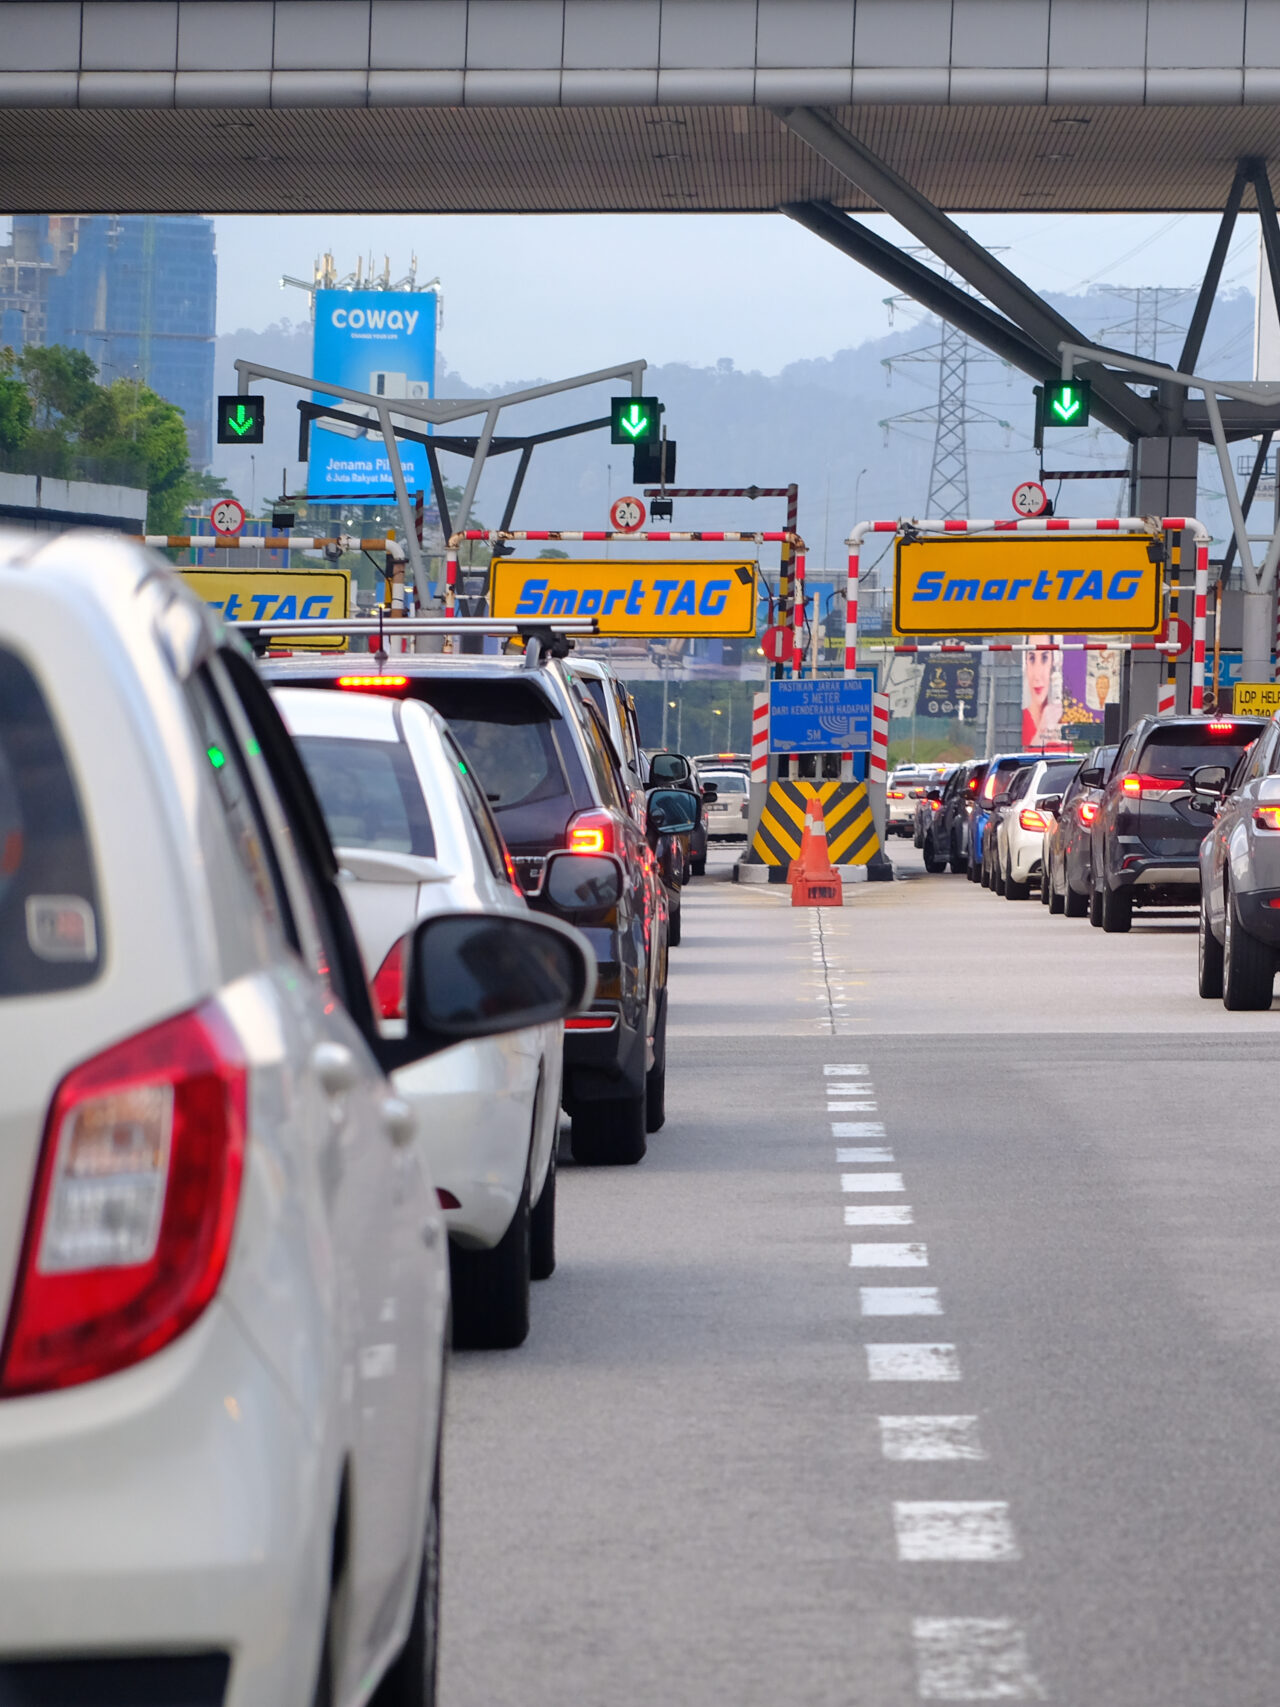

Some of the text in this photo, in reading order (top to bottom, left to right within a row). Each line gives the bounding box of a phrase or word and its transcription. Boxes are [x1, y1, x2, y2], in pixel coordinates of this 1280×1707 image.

[326, 458, 373, 471] Jenama
[912, 570, 1144, 602] SmartTAG
[778, 680, 863, 692] PASTIKAN JARAK ANDA
[803, 692, 841, 704] 5 METER
[1240, 691, 1257, 704] LDP
[772, 704, 870, 716] DARI KENDERAAN HADAPAN
[806, 729, 821, 741] 5M
